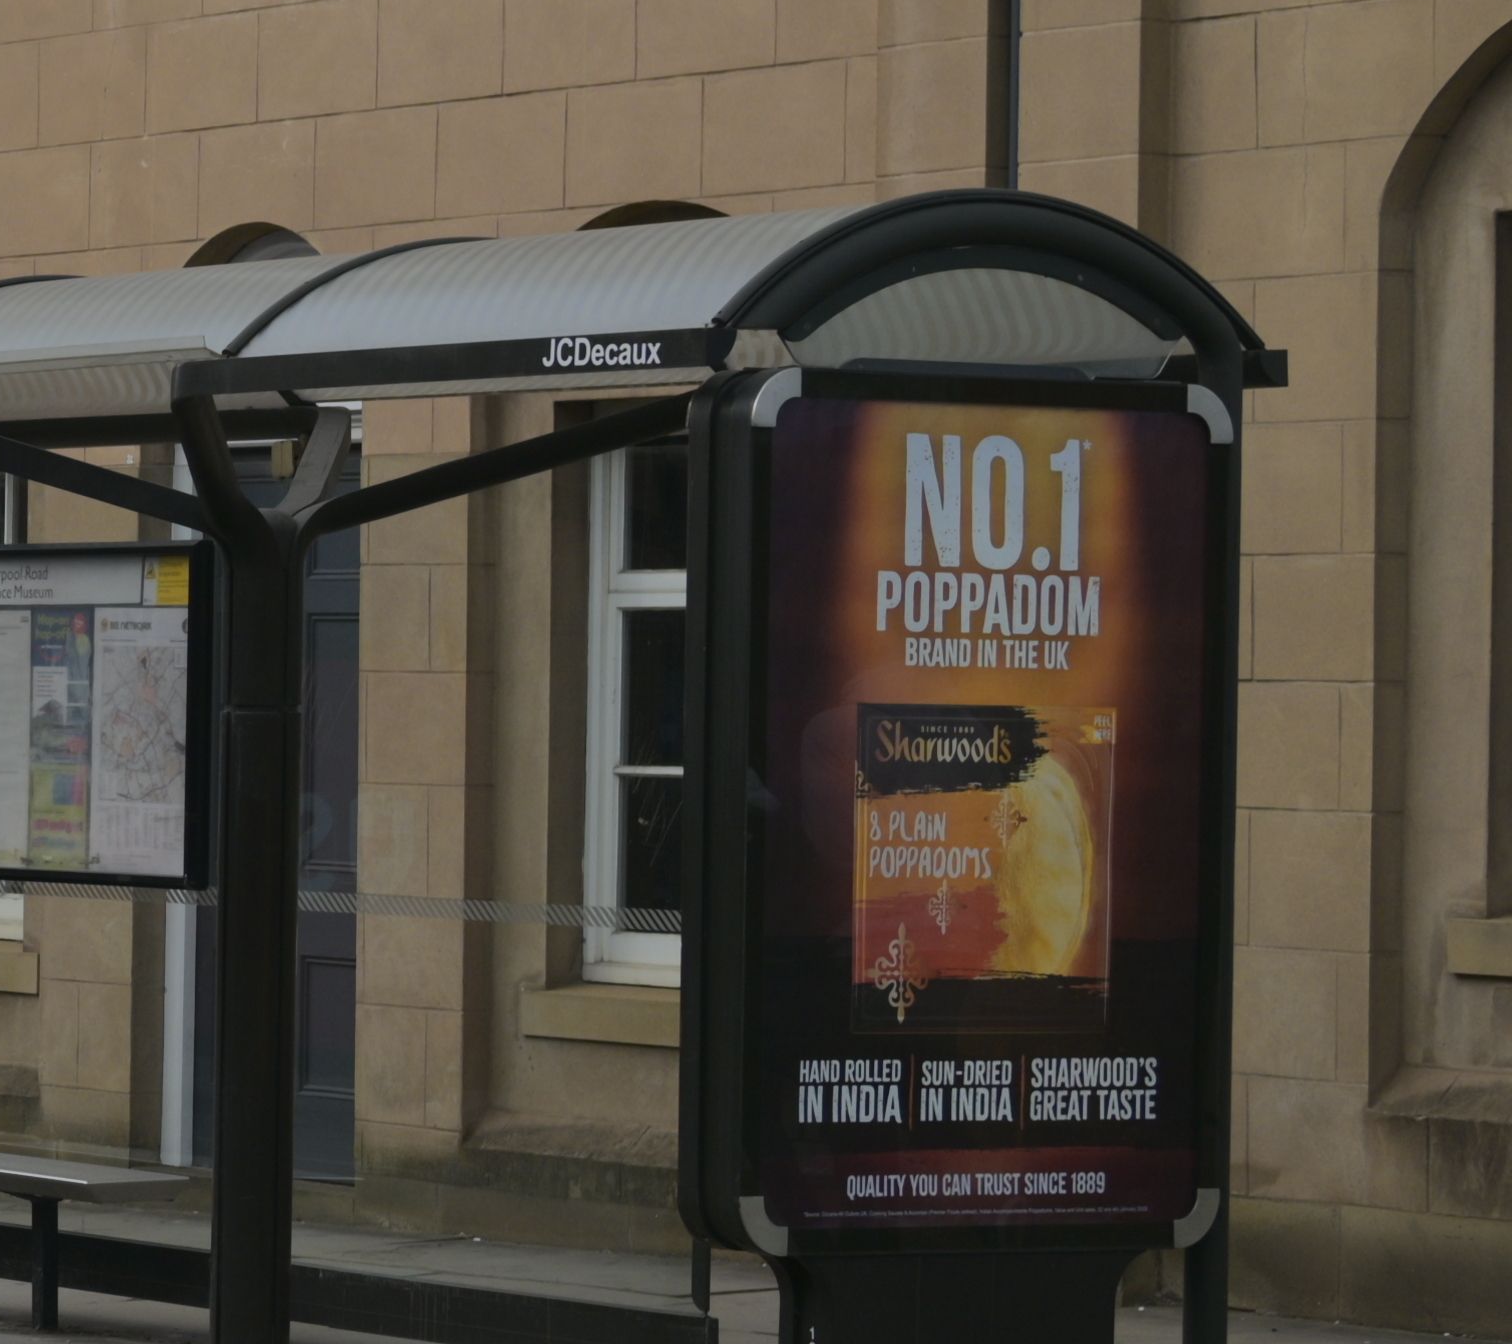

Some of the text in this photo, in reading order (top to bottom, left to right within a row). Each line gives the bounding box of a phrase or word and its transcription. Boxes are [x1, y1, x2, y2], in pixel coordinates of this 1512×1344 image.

[542, 337, 662, 367] JCDecaux
[25, 566, 49, 581] Road
[13, 586, 54, 599] Museum
[876, 570, 1101, 637] POPPADOM
[905, 637, 1070, 670] BRAND IN THE UK
[875, 720, 1012, 764] Sharwood's
[870, 810, 882, 841] 8
[868, 846, 993, 879] POPPADOMS
[799, 1059, 901, 1084] HAND ROLLED
[921, 1060, 1012, 1086] SUN-DRIED
[1030, 1057, 1157, 1089] SHARWOOD'S
[798, 1084, 903, 1124] IN INDIA
[920, 1087, 1013, 1122] IN INDIA
[1029, 1089, 1157, 1122] GREAT TASTE
[846, 1171, 1106, 1201] QUALITY YOU CAN TRUST SINCE 1889
